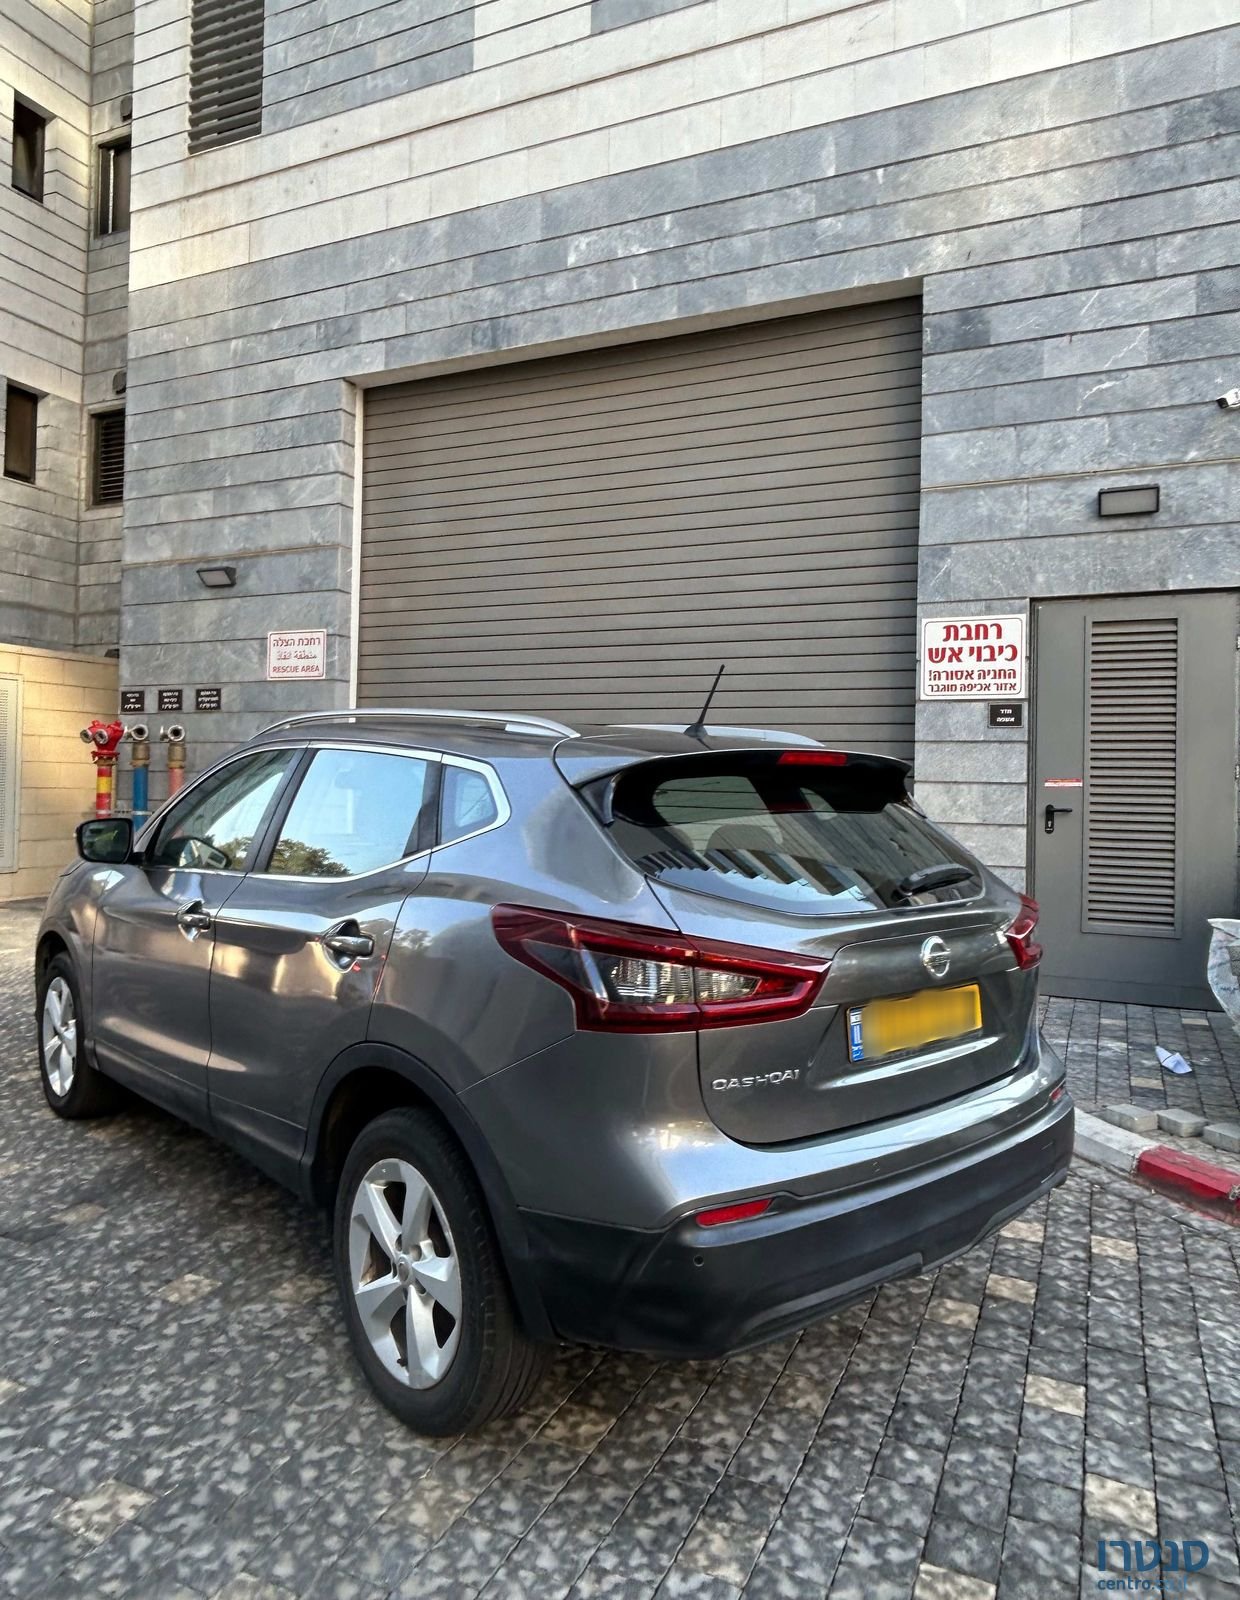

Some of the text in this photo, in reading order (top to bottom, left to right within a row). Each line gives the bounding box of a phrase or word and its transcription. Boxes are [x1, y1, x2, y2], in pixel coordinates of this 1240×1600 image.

[942, 623, 1003, 642] רחבת
[273, 637, 321, 647] רחבת הצלה
[928, 644, 1018, 664] כיבוי אש
[272, 664, 320, 673] RESCUE AREA
[928, 668, 1017, 682] החניה אסורה!
[928, 682, 1017, 693] אזור אכיפה מוגבר
[711, 1069, 800, 1091] QASHQAI
